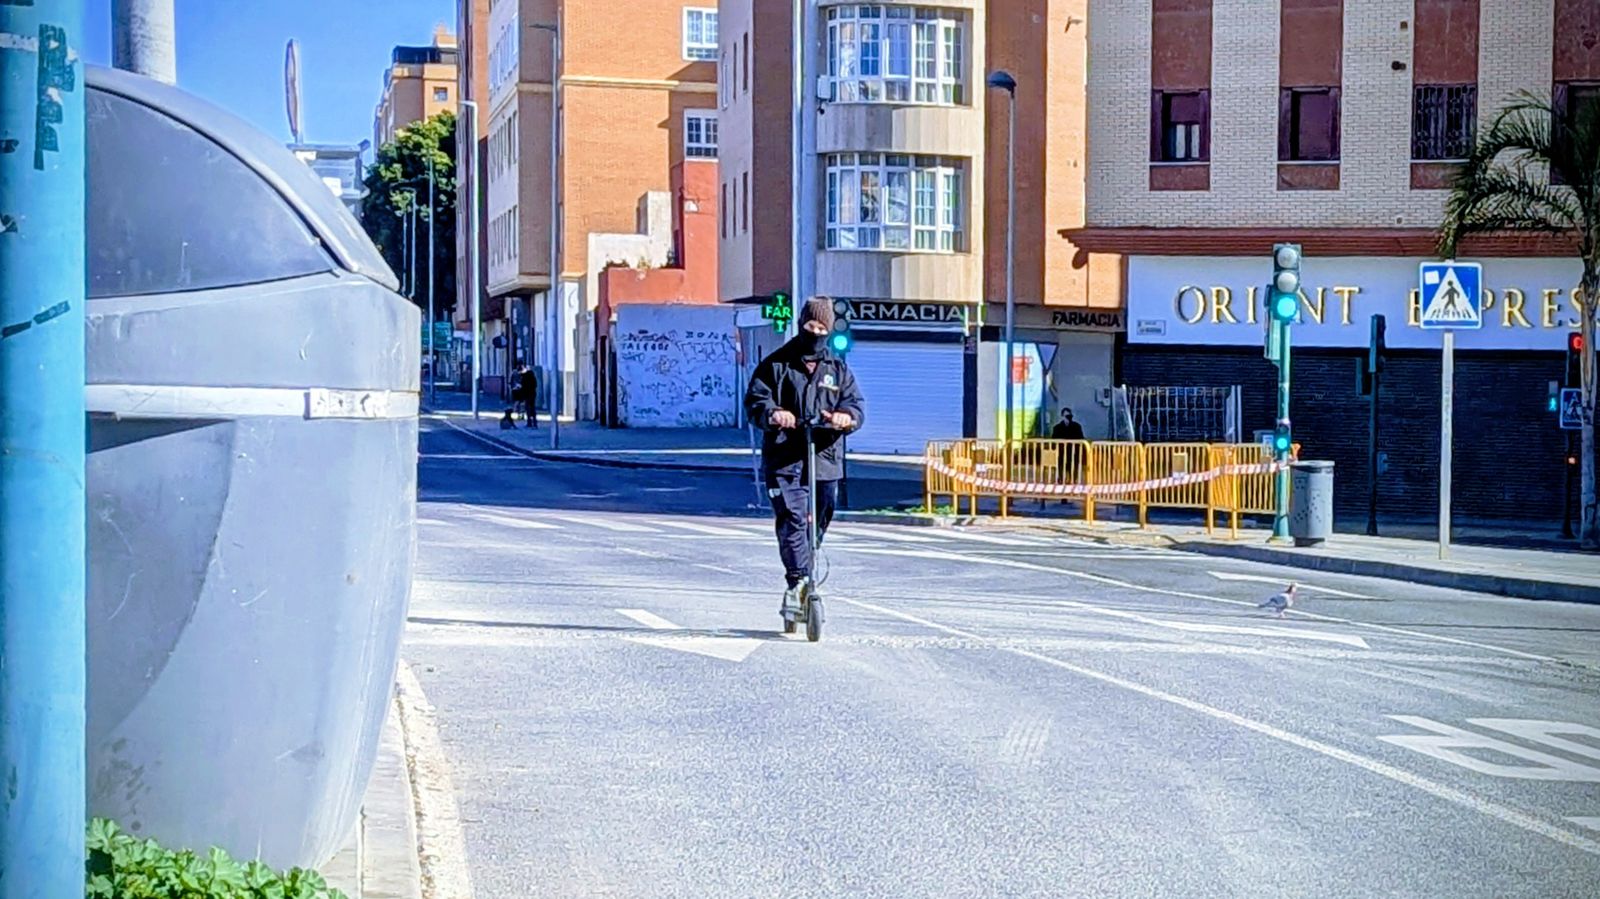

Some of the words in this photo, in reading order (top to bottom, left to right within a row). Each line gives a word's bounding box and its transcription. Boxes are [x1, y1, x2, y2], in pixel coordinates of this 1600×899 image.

[766, 306, 793, 318] FAR
[848, 302, 964, 321] ARMACIA
[1175, 286, 1361, 325] ORINT
[1052, 310, 1121, 328] FARMACIA
